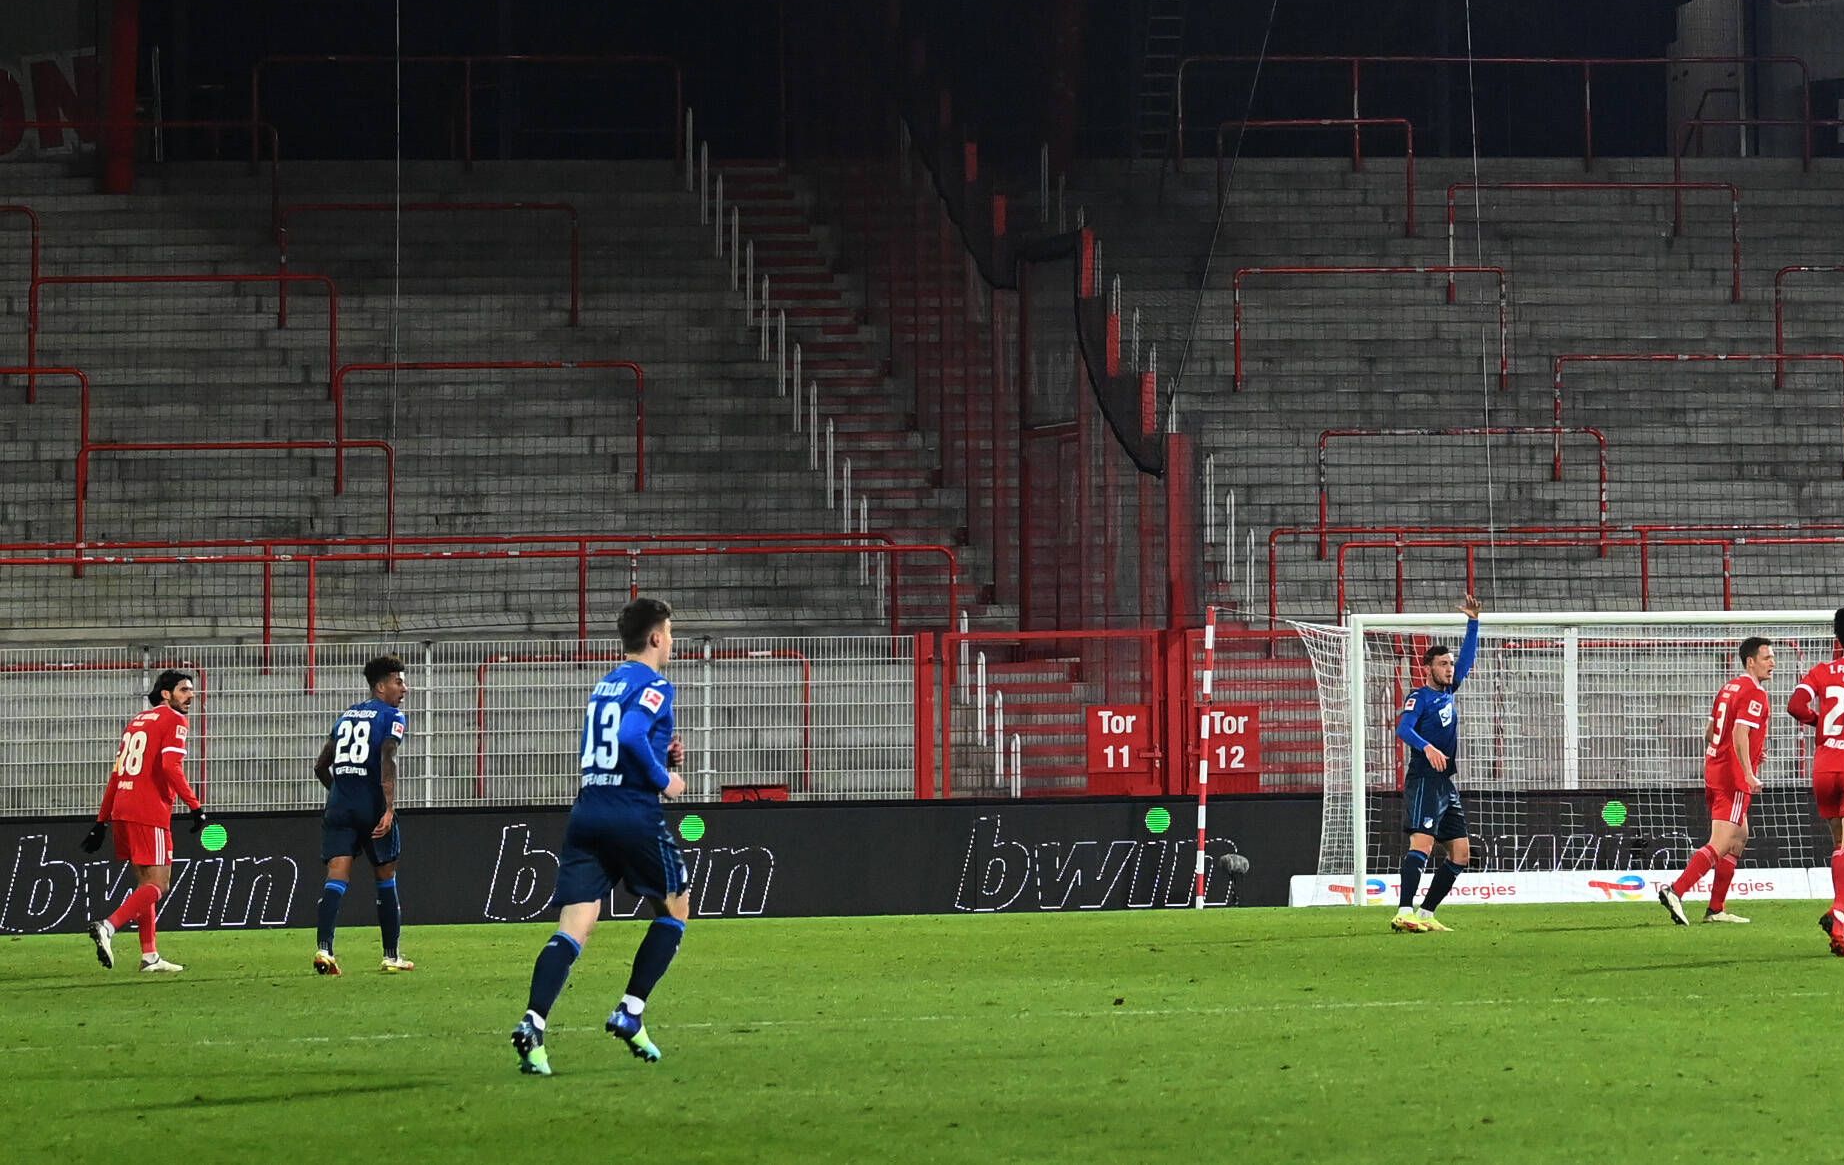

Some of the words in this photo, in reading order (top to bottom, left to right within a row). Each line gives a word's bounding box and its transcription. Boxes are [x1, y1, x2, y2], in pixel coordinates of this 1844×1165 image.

[1098, 711, 1136, 734] Tor
[1211, 711, 1249, 735] Tor
[335, 720, 371, 764] 28
[581, 701, 622, 770] 13
[1103, 745, 1130, 769] 11
[1215, 745, 1245, 769] 12
[954, 806, 1239, 912] bwin
